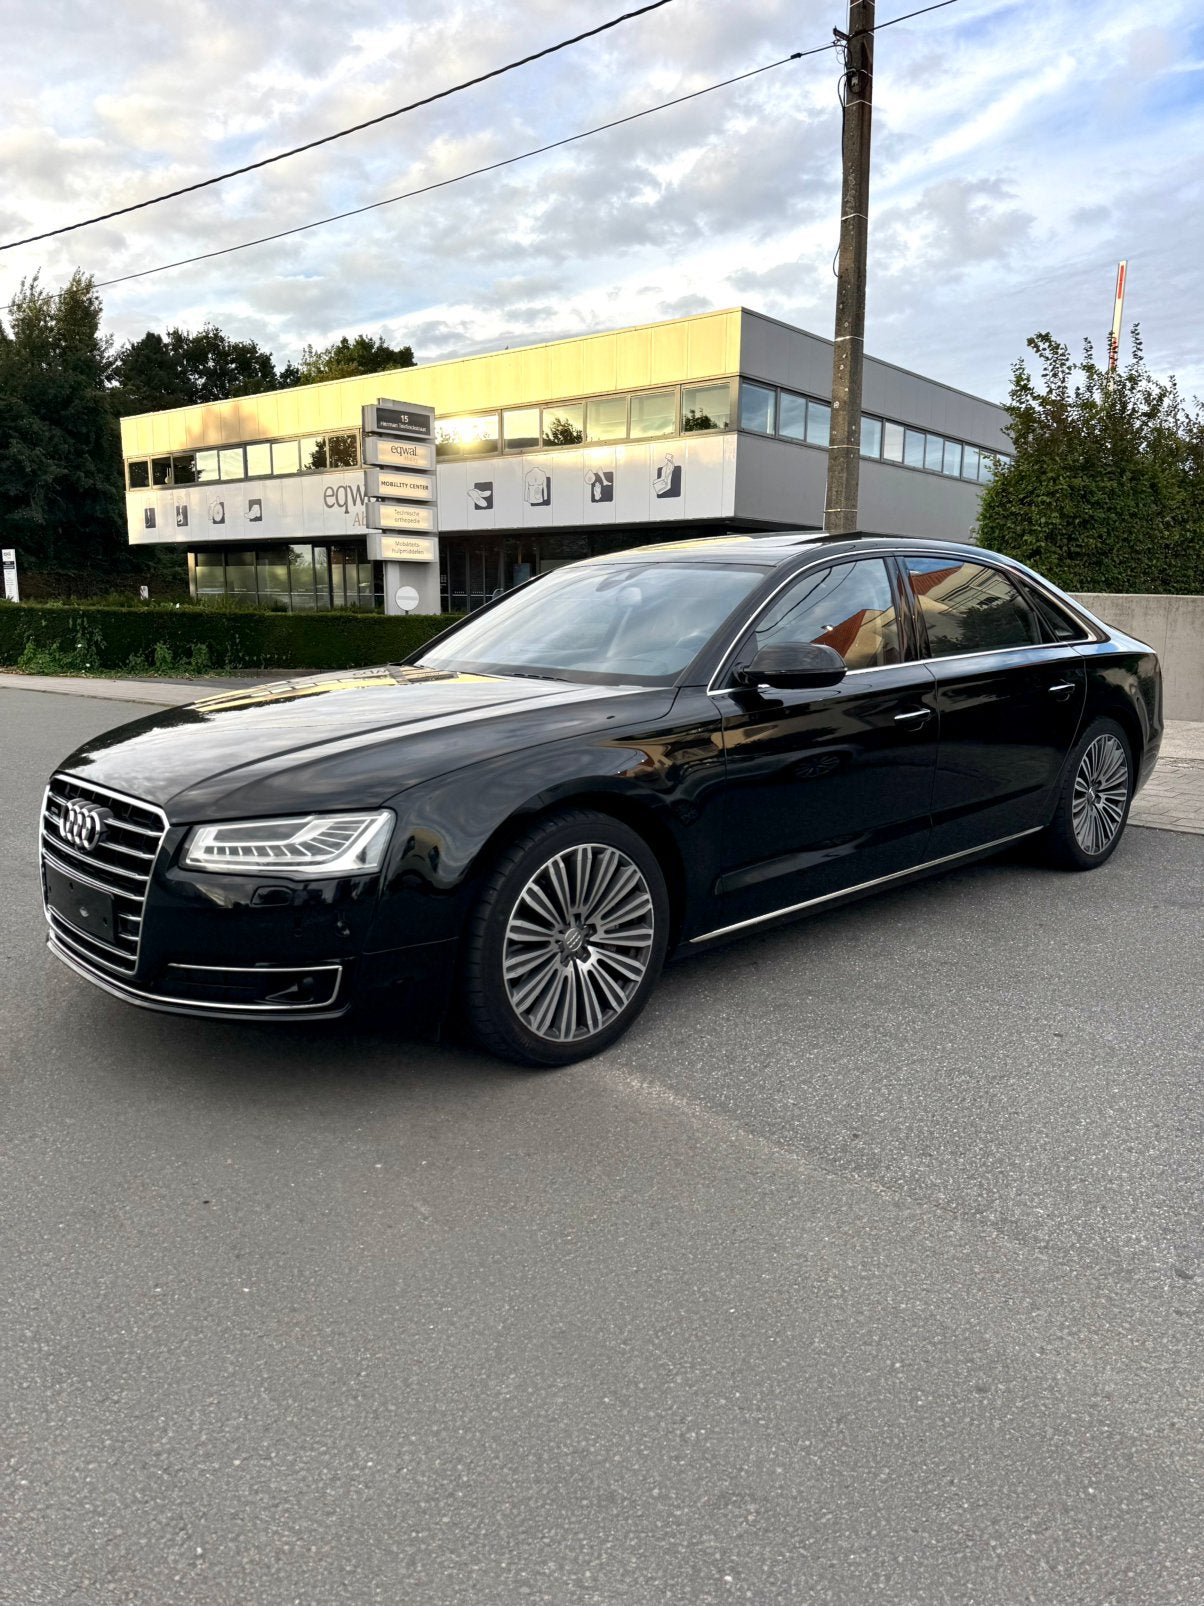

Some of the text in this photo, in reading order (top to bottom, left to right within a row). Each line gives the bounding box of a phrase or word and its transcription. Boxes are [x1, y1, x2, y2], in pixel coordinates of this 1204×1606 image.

[400, 414, 409, 423] 15
[390, 445, 417, 457] eqwal
[381, 480, 409, 489] MOBILITY
